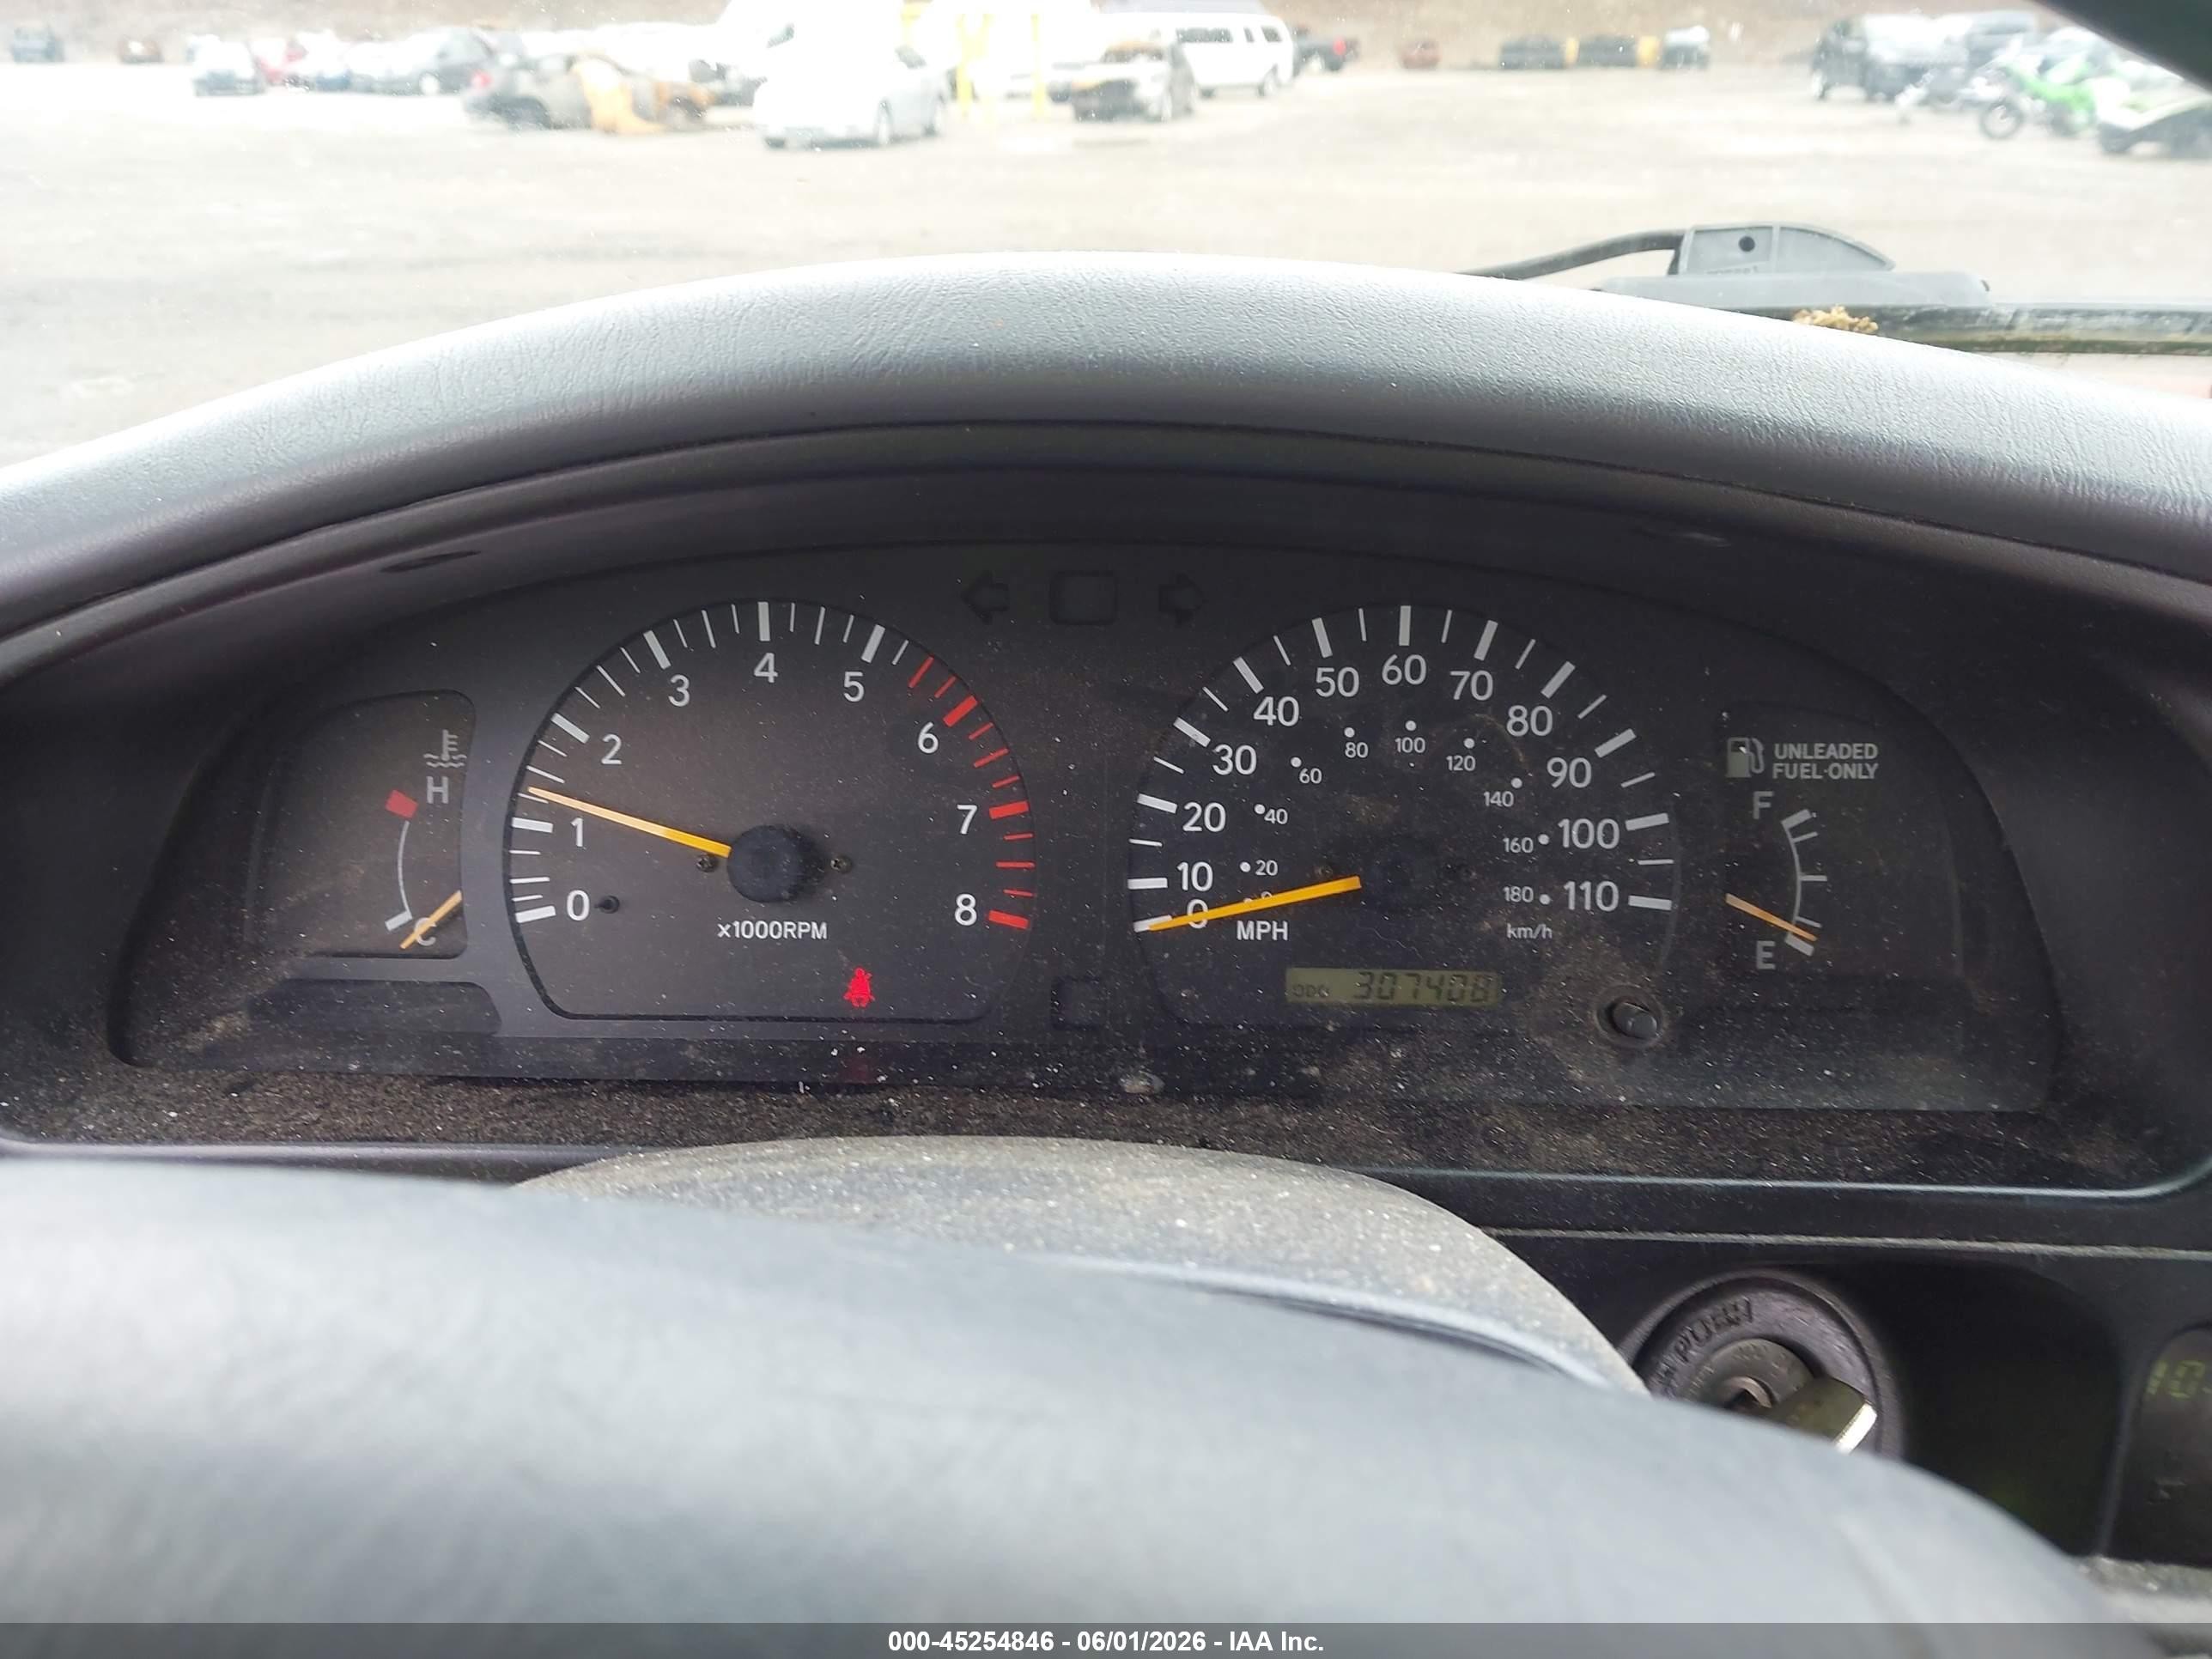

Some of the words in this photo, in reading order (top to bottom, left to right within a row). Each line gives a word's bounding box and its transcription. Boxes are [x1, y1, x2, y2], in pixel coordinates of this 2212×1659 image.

[754, 652, 778, 684] 4
[1315, 666, 1359, 698] 50
[1382, 654, 1426, 686] 60
[668, 674, 690, 708] 3
[843, 671, 865, 703] 5
[1449, 670, 1494, 702] 70
[1253, 696, 1300, 728] 40
[1506, 705, 1553, 738] 80
[601, 733, 623, 766] 2
[918, 721, 939, 755] 6
[1345, 741, 1369, 758] 80
[1395, 737, 1426, 754] 100
[1774, 743, 1879, 760] UNLEADED
[1212, 744, 1258, 776] 30
[1446, 755, 1477, 772] 120
[1547, 757, 1592, 789] 90
[427, 776, 449, 804] H
[1299, 768, 1322, 785] 60
[1483, 790, 1514, 808] 140
[1753, 790, 1774, 820] F
[957, 804, 978, 836] 7
[1182, 800, 1226, 833] 20
[1264, 808, 1289, 825] 40
[571, 817, 584, 848] 1
[1503, 836, 1534, 854] 160
[1557, 818, 1620, 850] 100
[1176, 861, 1213, 892] 10
[1255, 860, 1279, 876] 20
[567, 890, 591, 922] 0
[1504, 885, 1534, 903] 180
[1563, 880, 1620, 913] 110
[954, 893, 978, 927] 8
[1187, 898, 1209, 929] 0
[717, 920, 829, 941] x1000RPM
[1237, 920, 1289, 941] MPH
[1506, 922, 1553, 942] km/h
[1756, 940, 1777, 970] E
